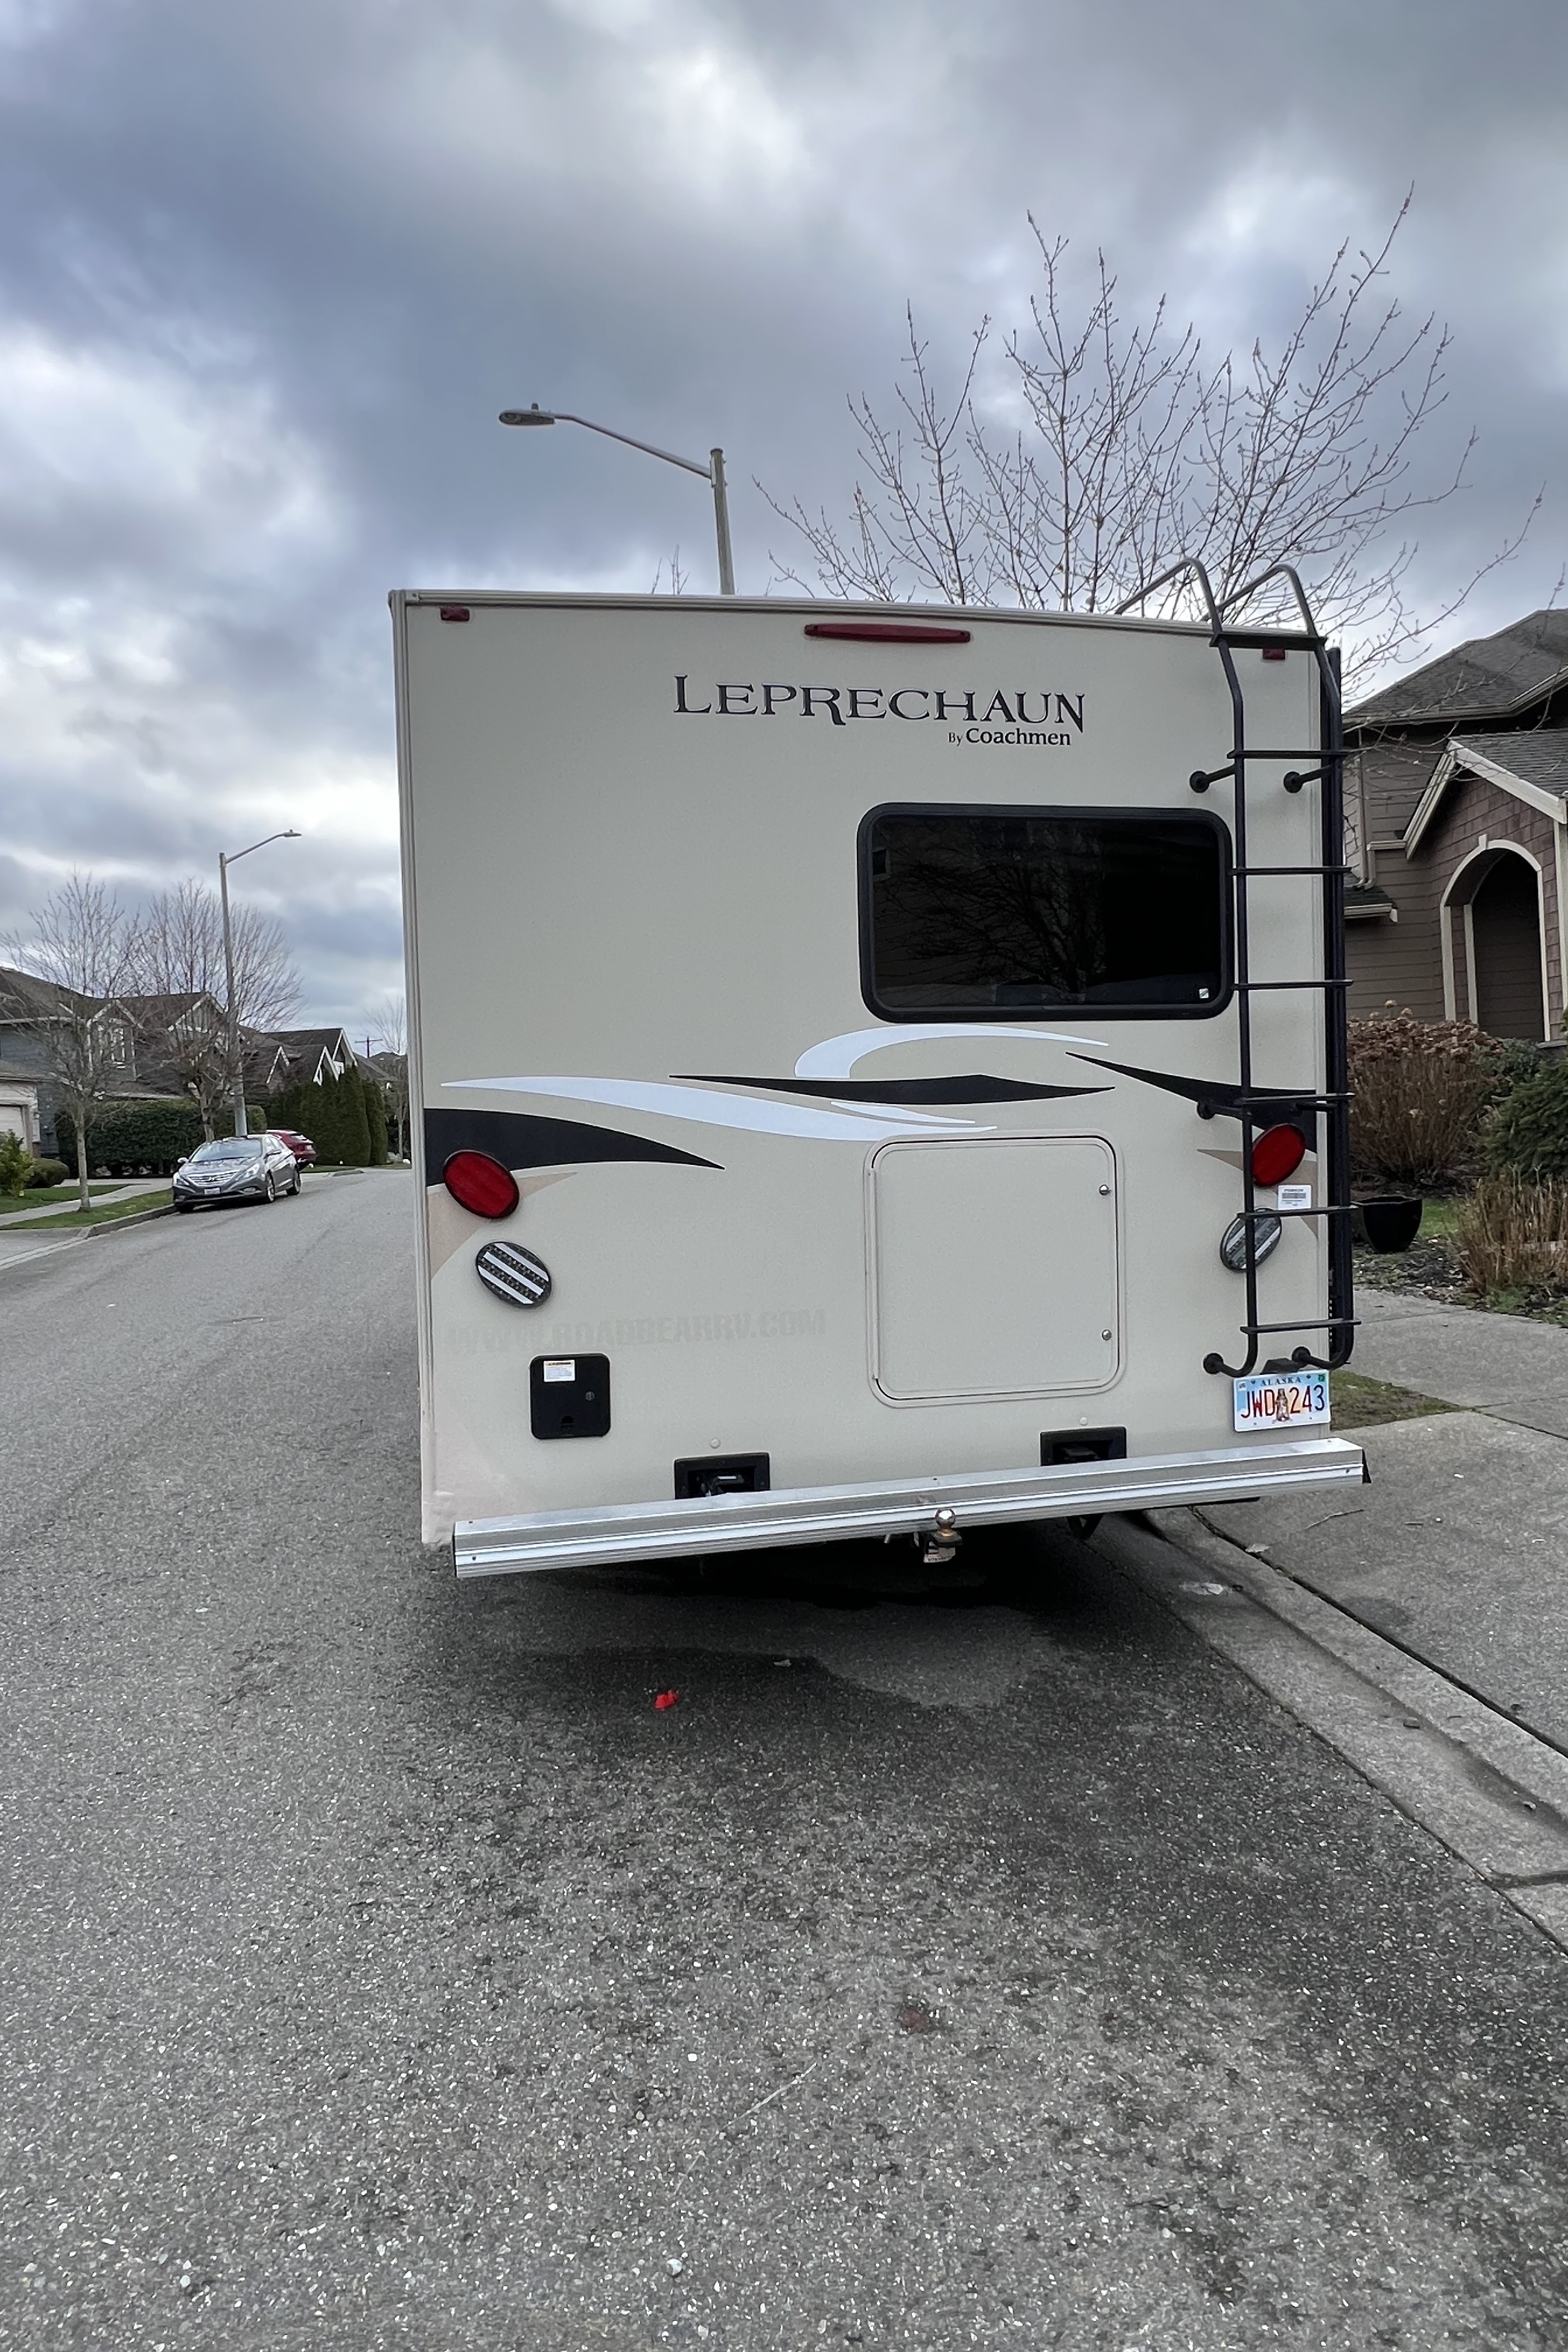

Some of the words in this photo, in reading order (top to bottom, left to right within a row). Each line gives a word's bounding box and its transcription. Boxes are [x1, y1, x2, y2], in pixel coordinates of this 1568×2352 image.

[673, 674, 1086, 733] LEPRECHAUN
[949, 732, 963, 747] By
[965, 727, 1071, 746] Coachmen
[1261, 1376, 1301, 1386] ALASKA
